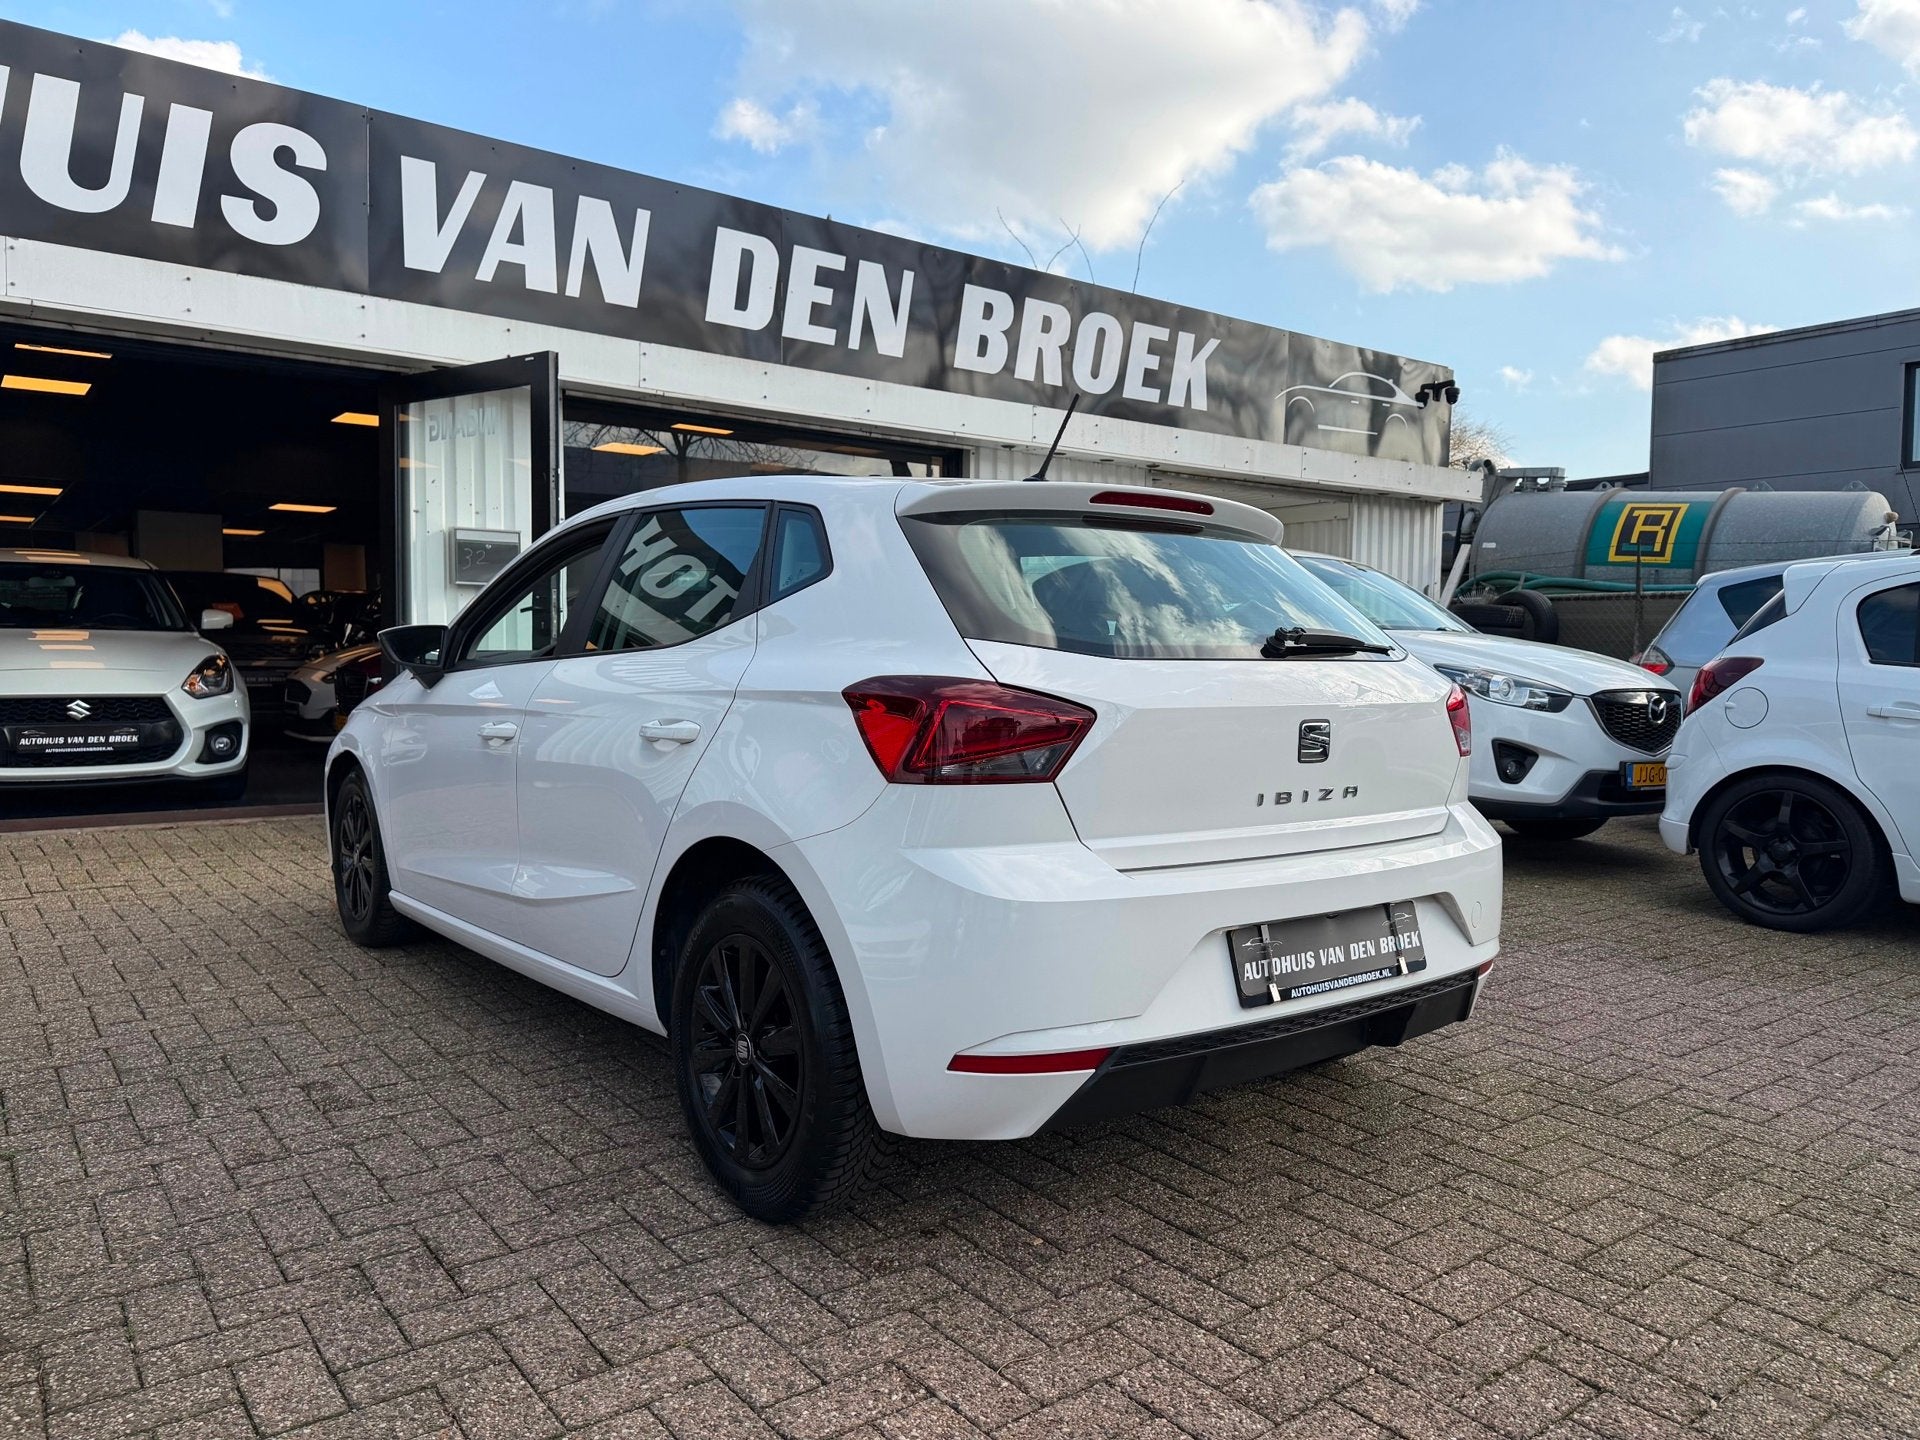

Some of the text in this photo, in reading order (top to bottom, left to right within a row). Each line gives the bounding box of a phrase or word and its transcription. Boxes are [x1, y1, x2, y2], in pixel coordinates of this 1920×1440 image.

[0, 65, 1221, 411] UIS VAN DEN BROEK
[19, 734, 140, 746] AUTOHUIS VAN DEN BROEK
[1636, 766, 1667, 783] JJG-0
[1256, 785, 1359, 807] IBIZA
[1243, 930, 1421, 981] AUTOHUIS VAN DEN BROEK
[1291, 968, 1392, 999] AUTOHUISVANDENBROEK.NL
